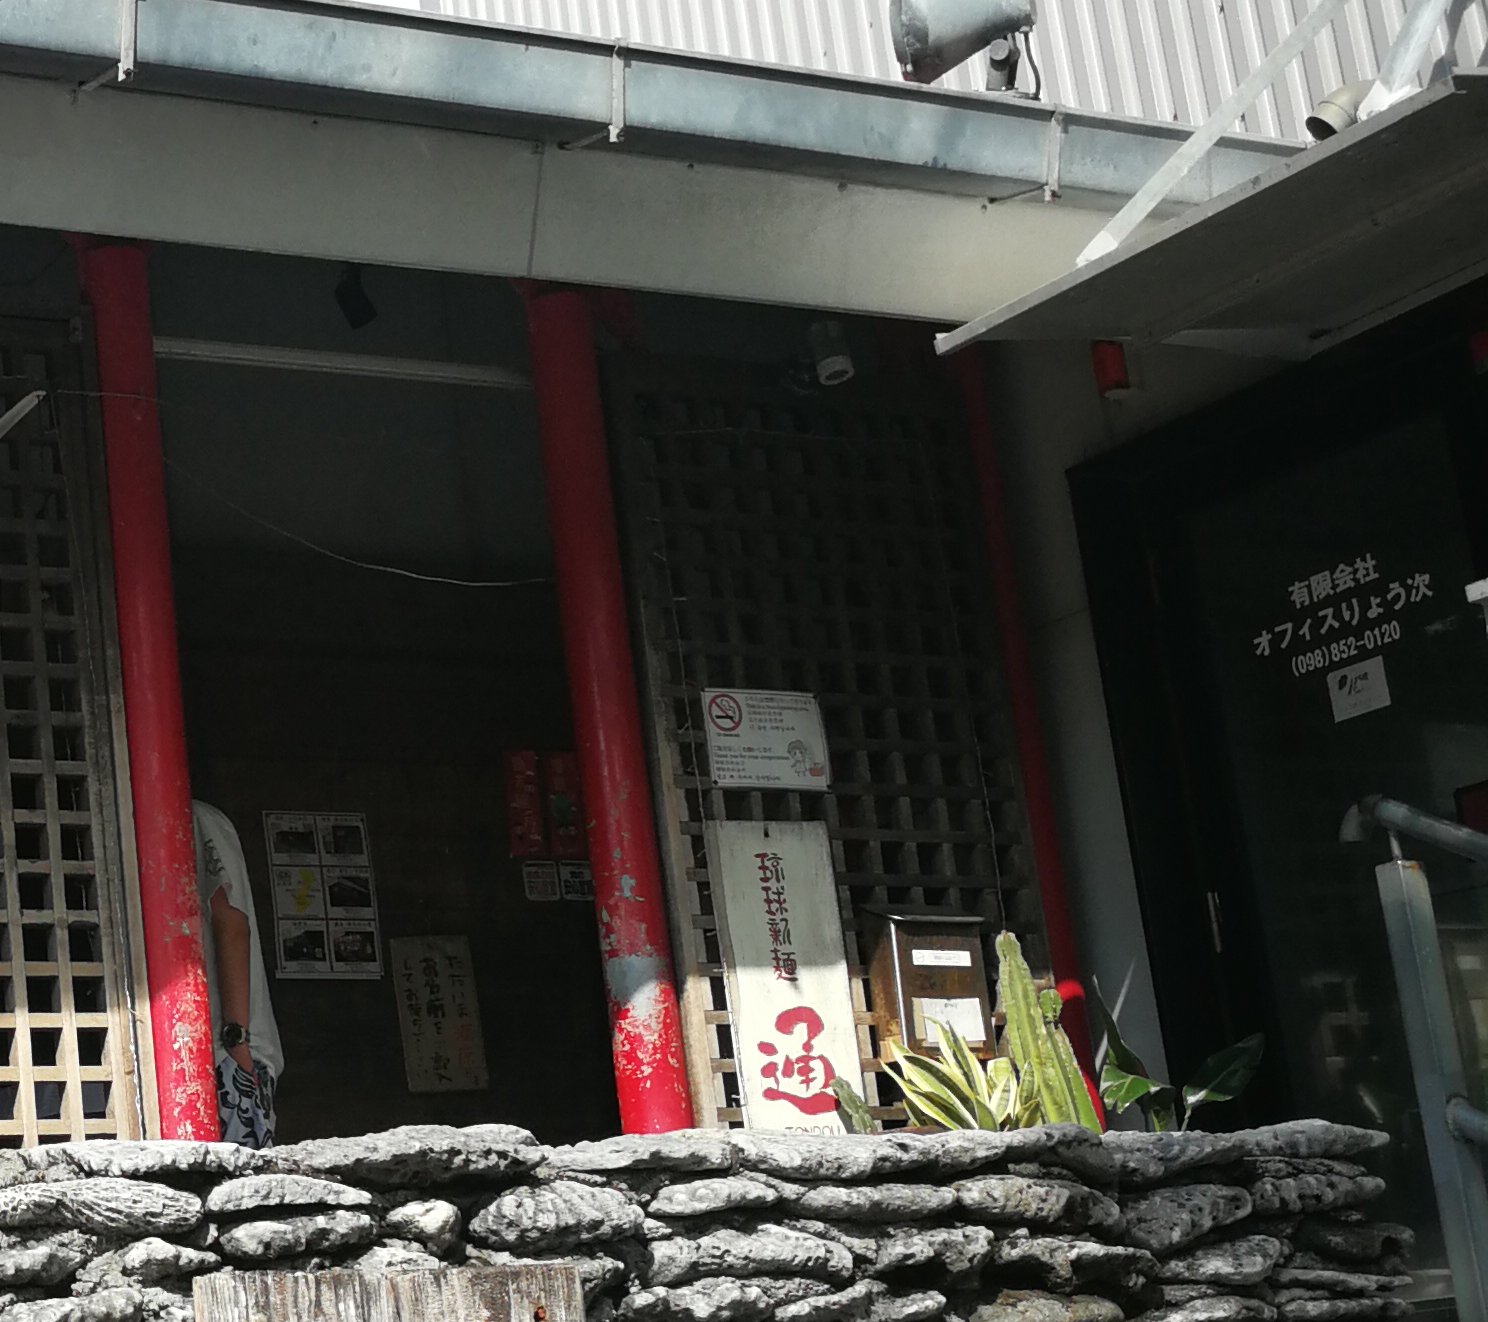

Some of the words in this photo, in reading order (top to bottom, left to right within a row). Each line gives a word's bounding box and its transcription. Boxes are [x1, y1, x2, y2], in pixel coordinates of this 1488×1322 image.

[1253, 573, 1433, 657] オフィスりょう次
[1288, 553, 1380, 609] 有限会社
[1291, 620, 1401, 676] (098)852-0120
[754, 852, 798, 982] 琉球新麺
